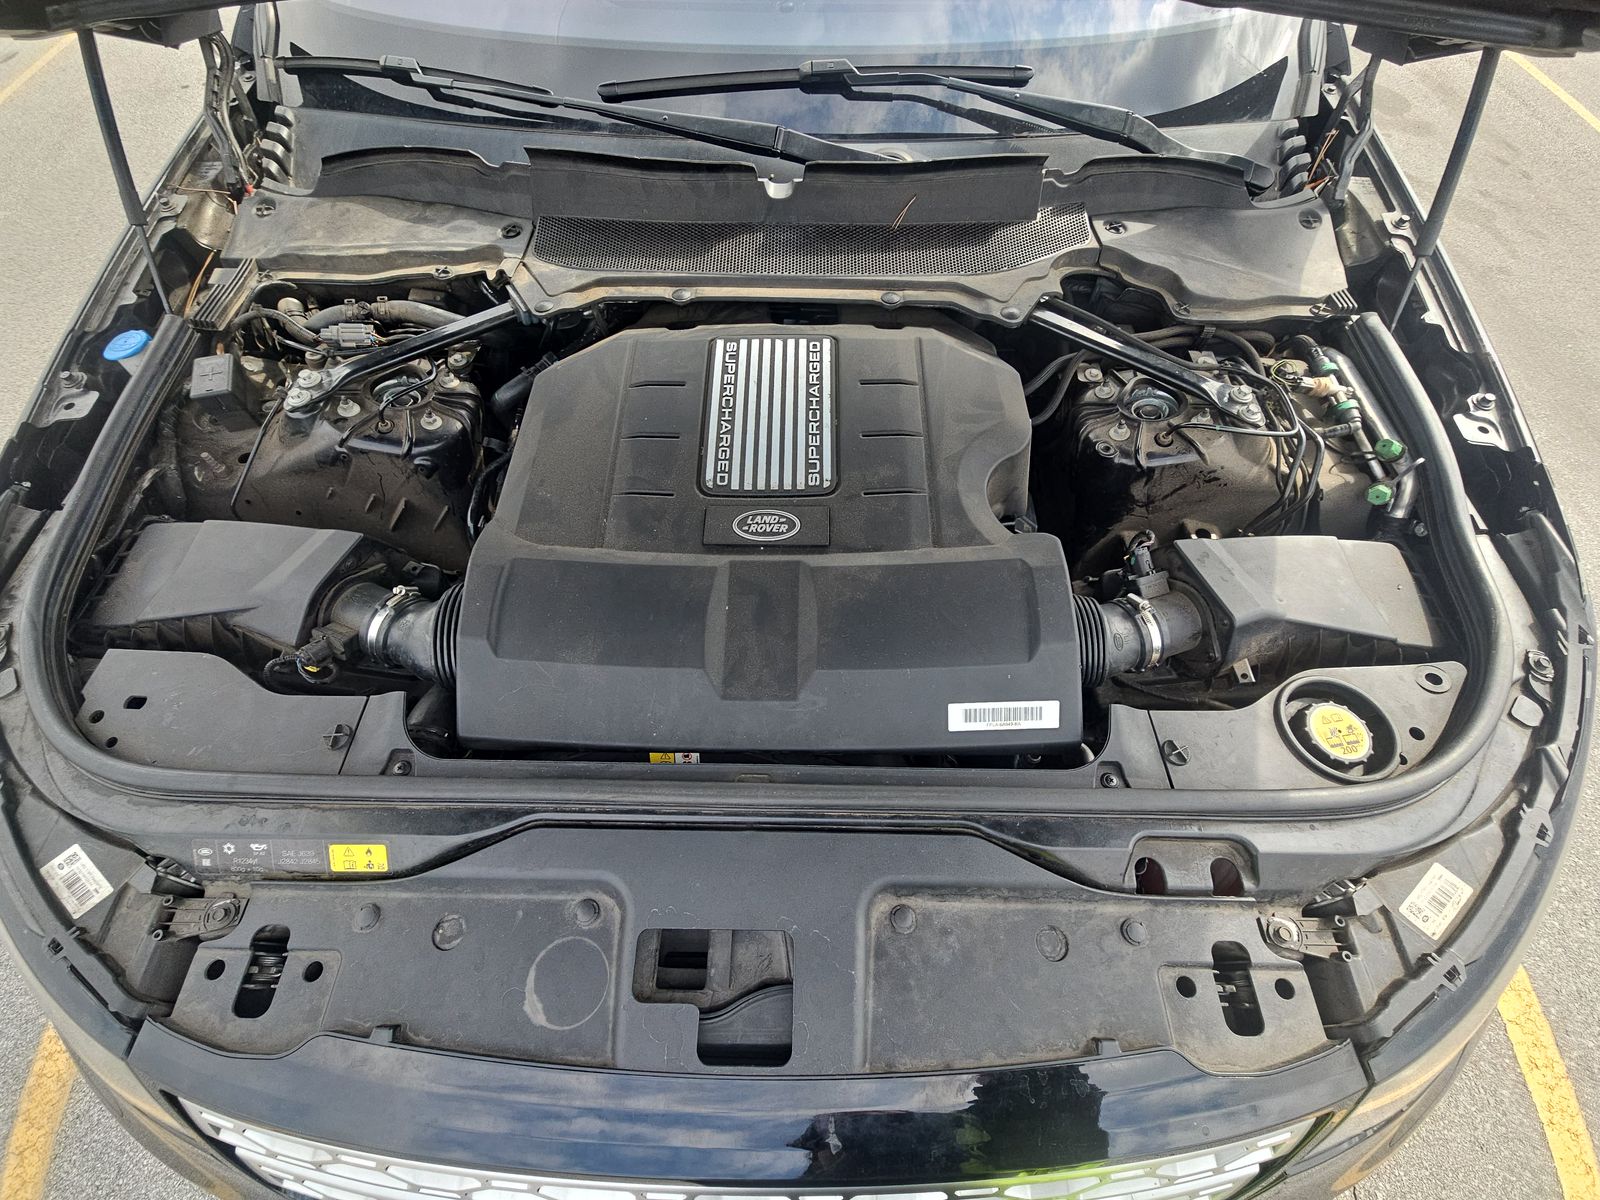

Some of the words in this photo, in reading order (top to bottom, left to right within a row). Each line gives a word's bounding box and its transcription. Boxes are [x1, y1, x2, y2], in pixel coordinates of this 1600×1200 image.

[716, 341, 737, 486] SUPERCHARGED
[808, 341, 821, 486] SUPERCHARGED
[747, 515, 778, 524] LAND
[748, 523, 788, 532] ROVER
[1341, 745, 1358, 755] 200
